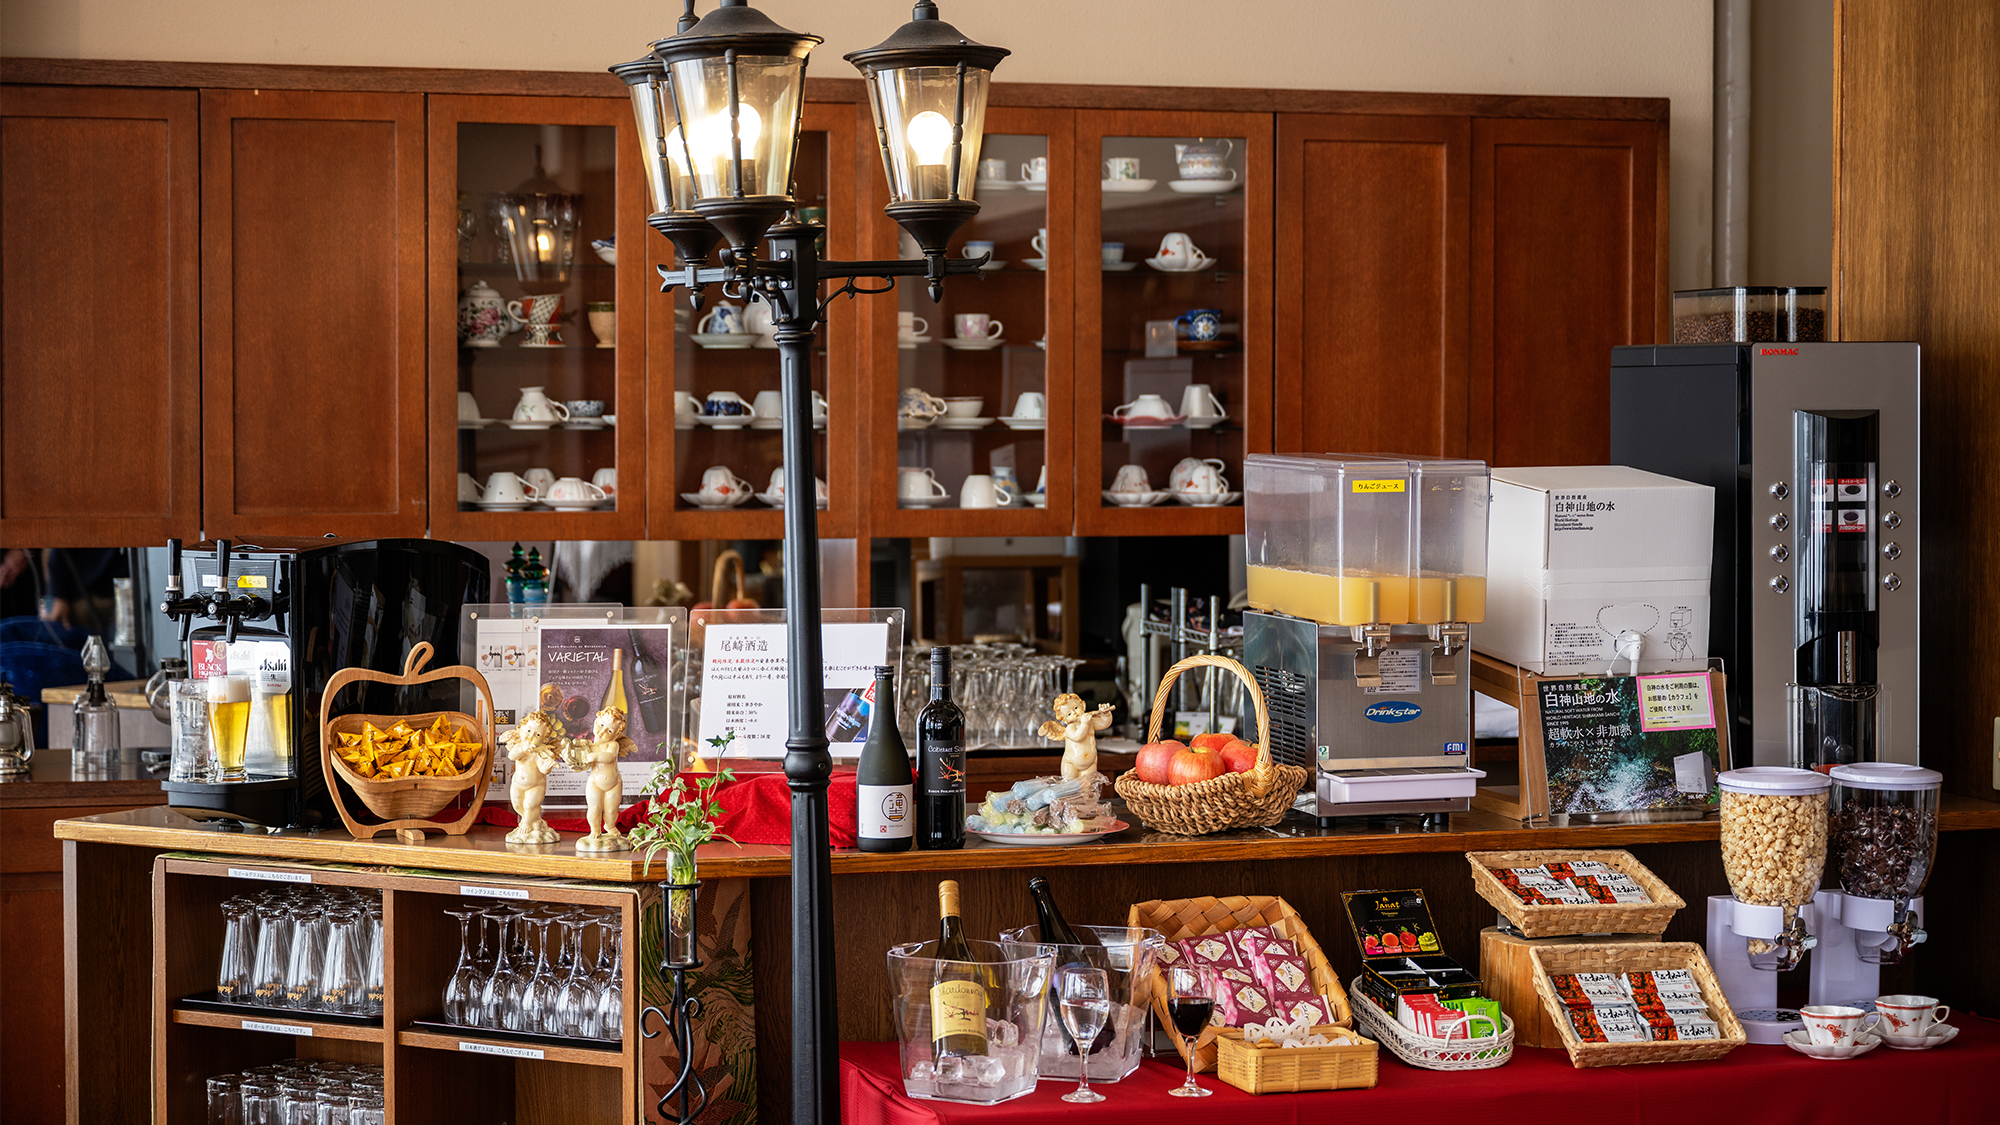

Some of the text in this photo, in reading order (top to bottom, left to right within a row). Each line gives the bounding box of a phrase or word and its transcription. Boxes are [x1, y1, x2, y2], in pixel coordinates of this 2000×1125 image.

[1556, 501, 1615, 512] 白神山地の水
[548, 652, 609, 662] VARIETAL
[198, 663, 222, 671] BLACK
[259, 658, 286, 671] Asahi
[1545, 688, 1620, 707] 白神山地の水
[1548, 724, 1632, 740] 超軟水×非加熱
[1375, 901, 1400, 910] Janat
